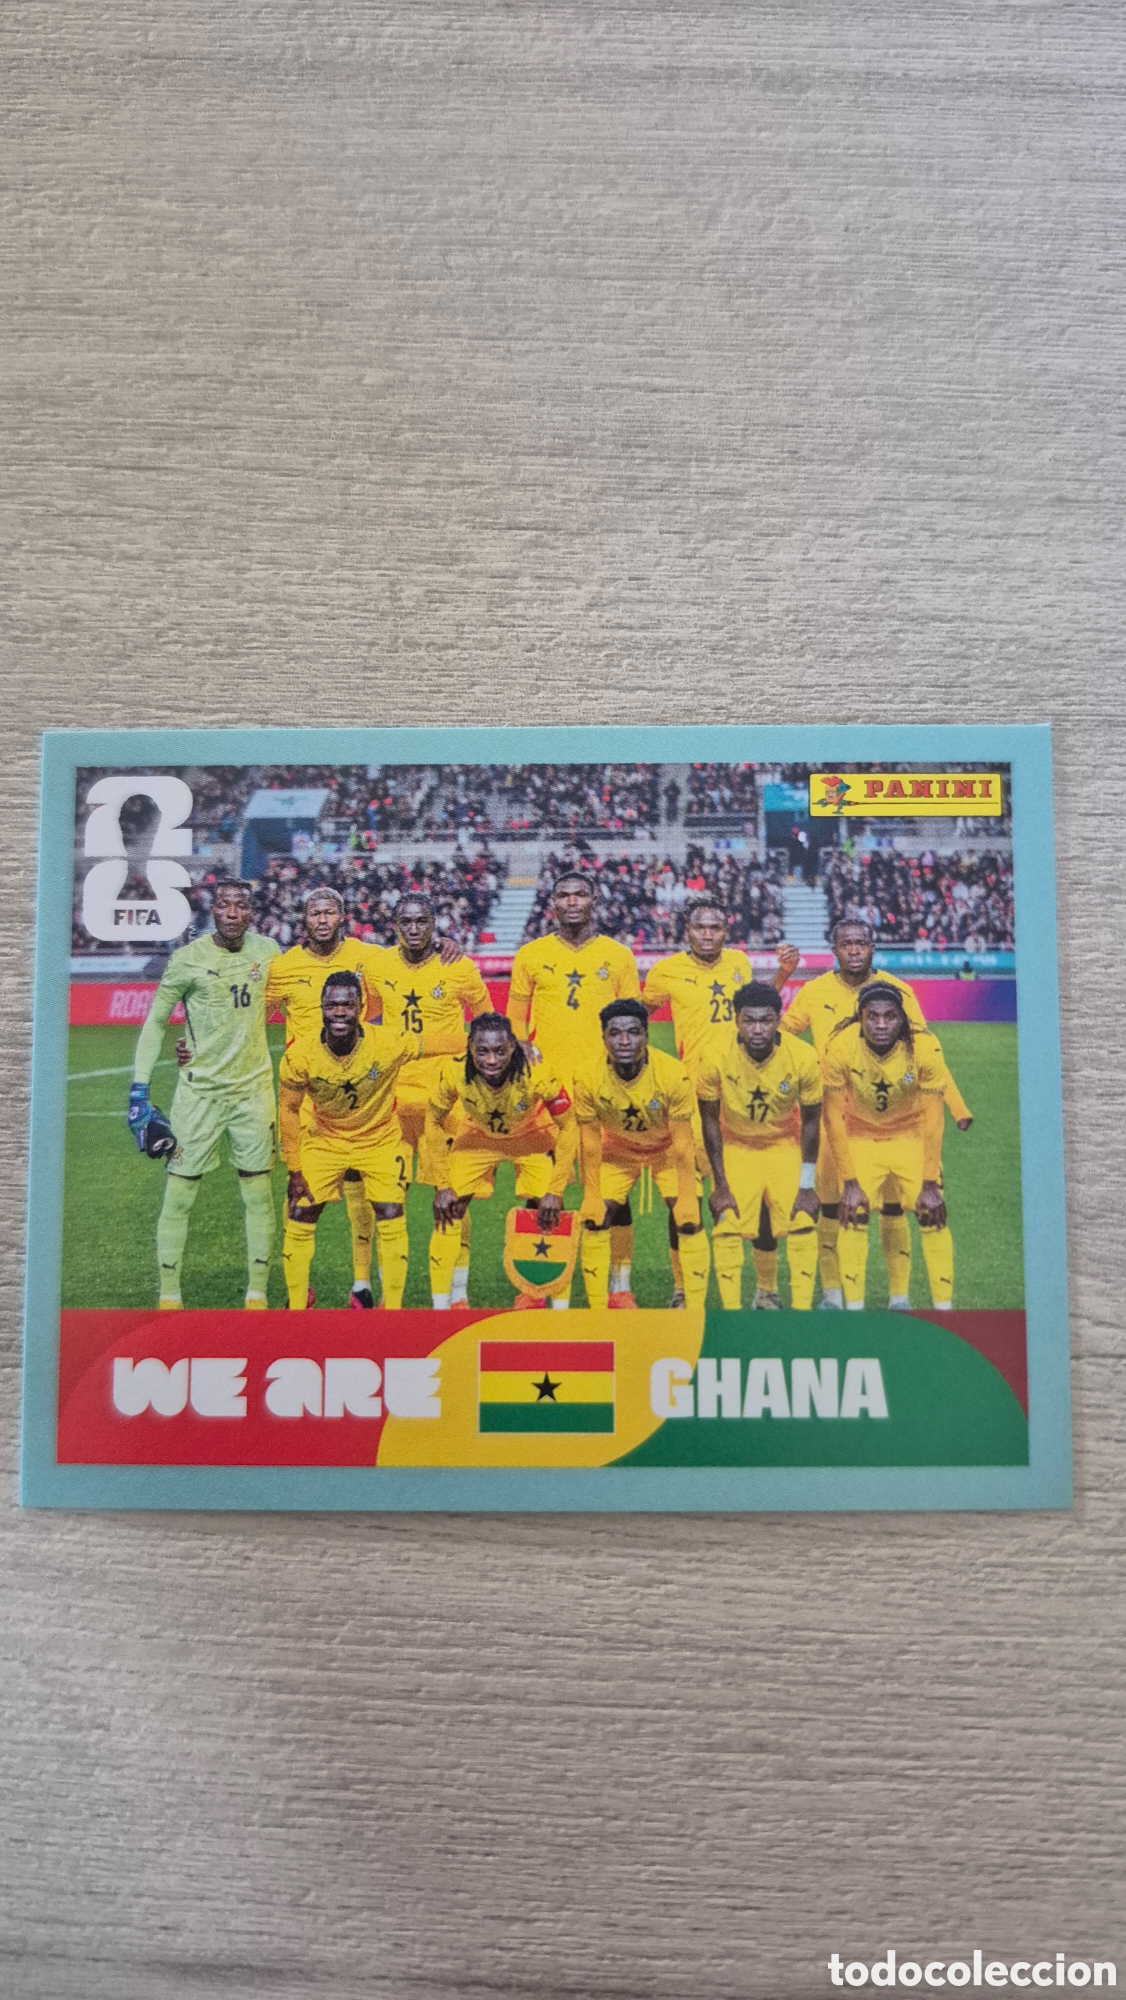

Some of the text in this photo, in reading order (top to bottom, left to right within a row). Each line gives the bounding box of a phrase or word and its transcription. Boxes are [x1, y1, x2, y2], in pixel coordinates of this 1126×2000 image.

[864, 779, 992, 799] PANINI
[114, 909, 162, 926] FIFA
[230, 983, 251, 1008] 16
[566, 986, 580, 1011] 4
[401, 1008, 424, 1034] 15
[709, 998, 734, 1024] 23
[347, 1093, 359, 1110] 2
[746, 1101, 770, 1124] 17
[875, 1094, 889, 1112] 3
[395, 1155, 407, 1181] 2
[113, 1357, 248, 1418] WE
[650, 1358, 889, 1419] GHANA
